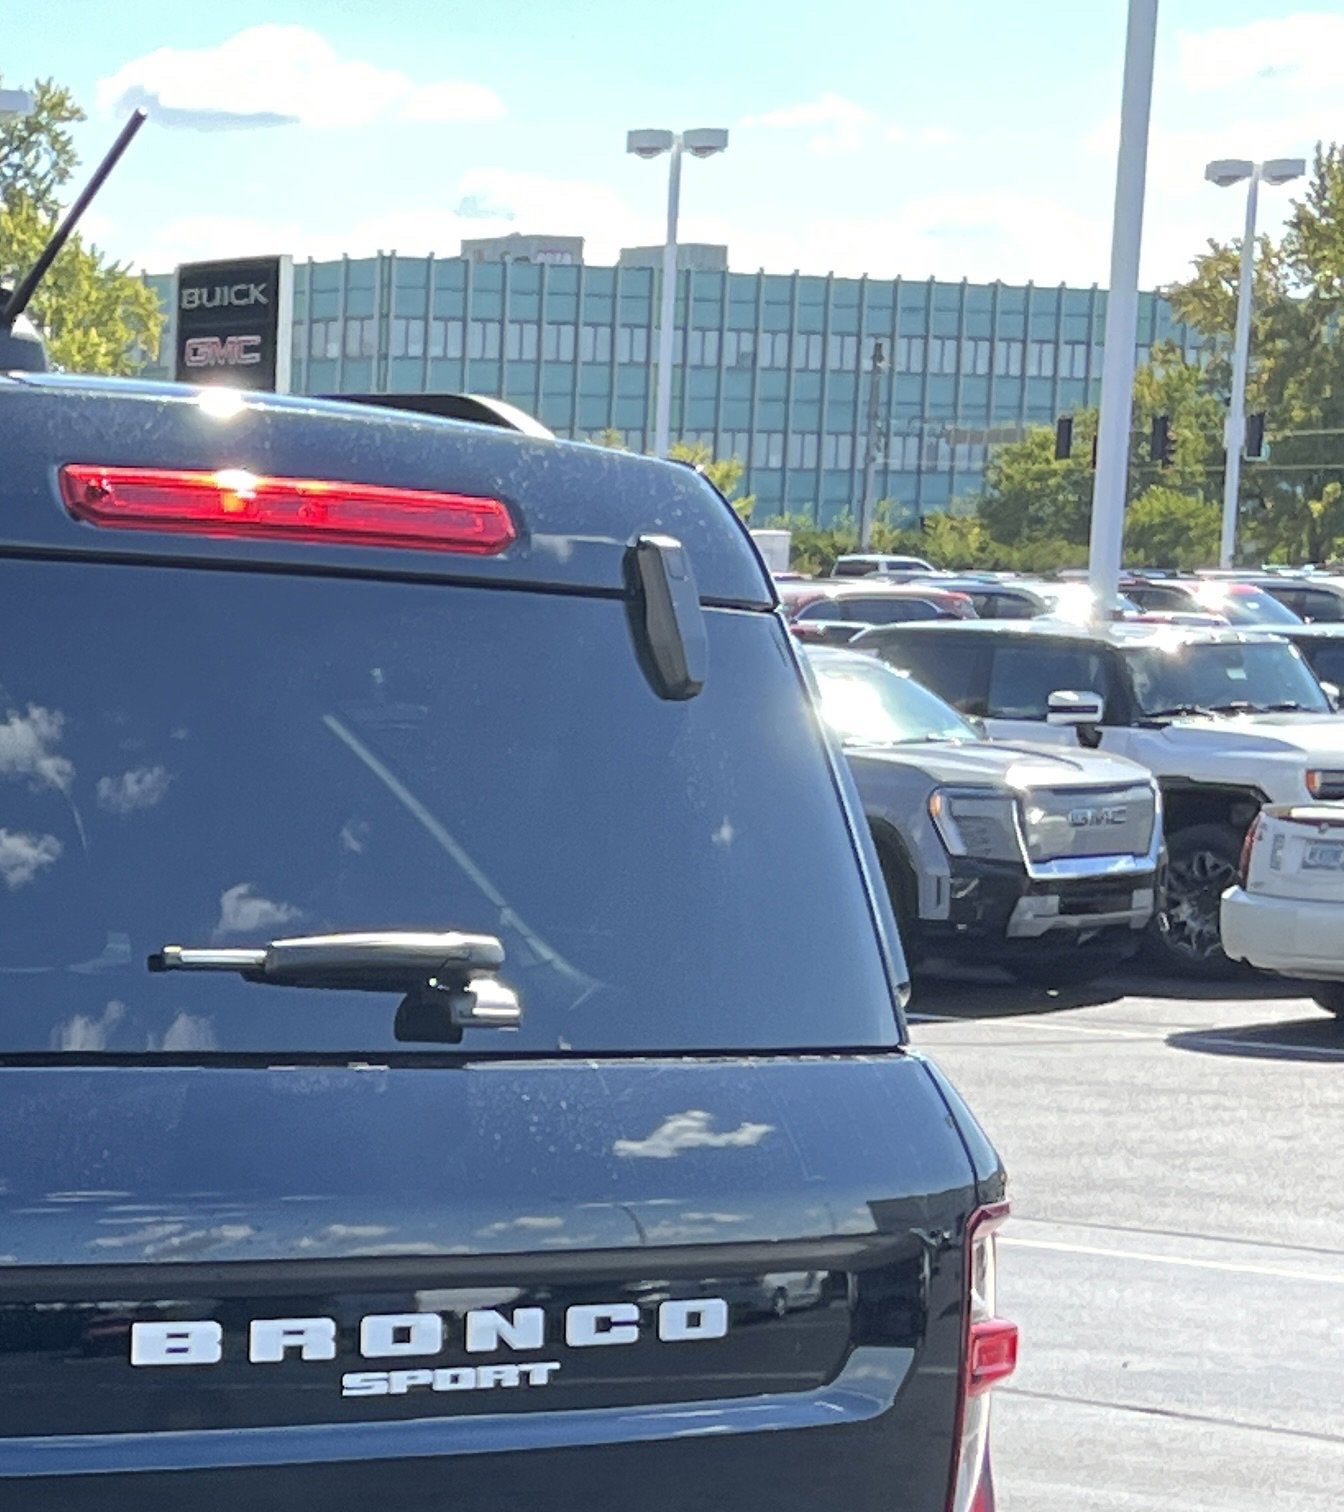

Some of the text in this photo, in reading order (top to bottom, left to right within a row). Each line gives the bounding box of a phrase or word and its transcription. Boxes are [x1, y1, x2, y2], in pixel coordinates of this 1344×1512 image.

[180, 282, 269, 310] BUICK
[185, 335, 261, 367] GMC
[1068, 806, 1127, 828] GMC
[130, 1298, 728, 1366] BRONCO
[342, 1362, 561, 1397] SPORT
